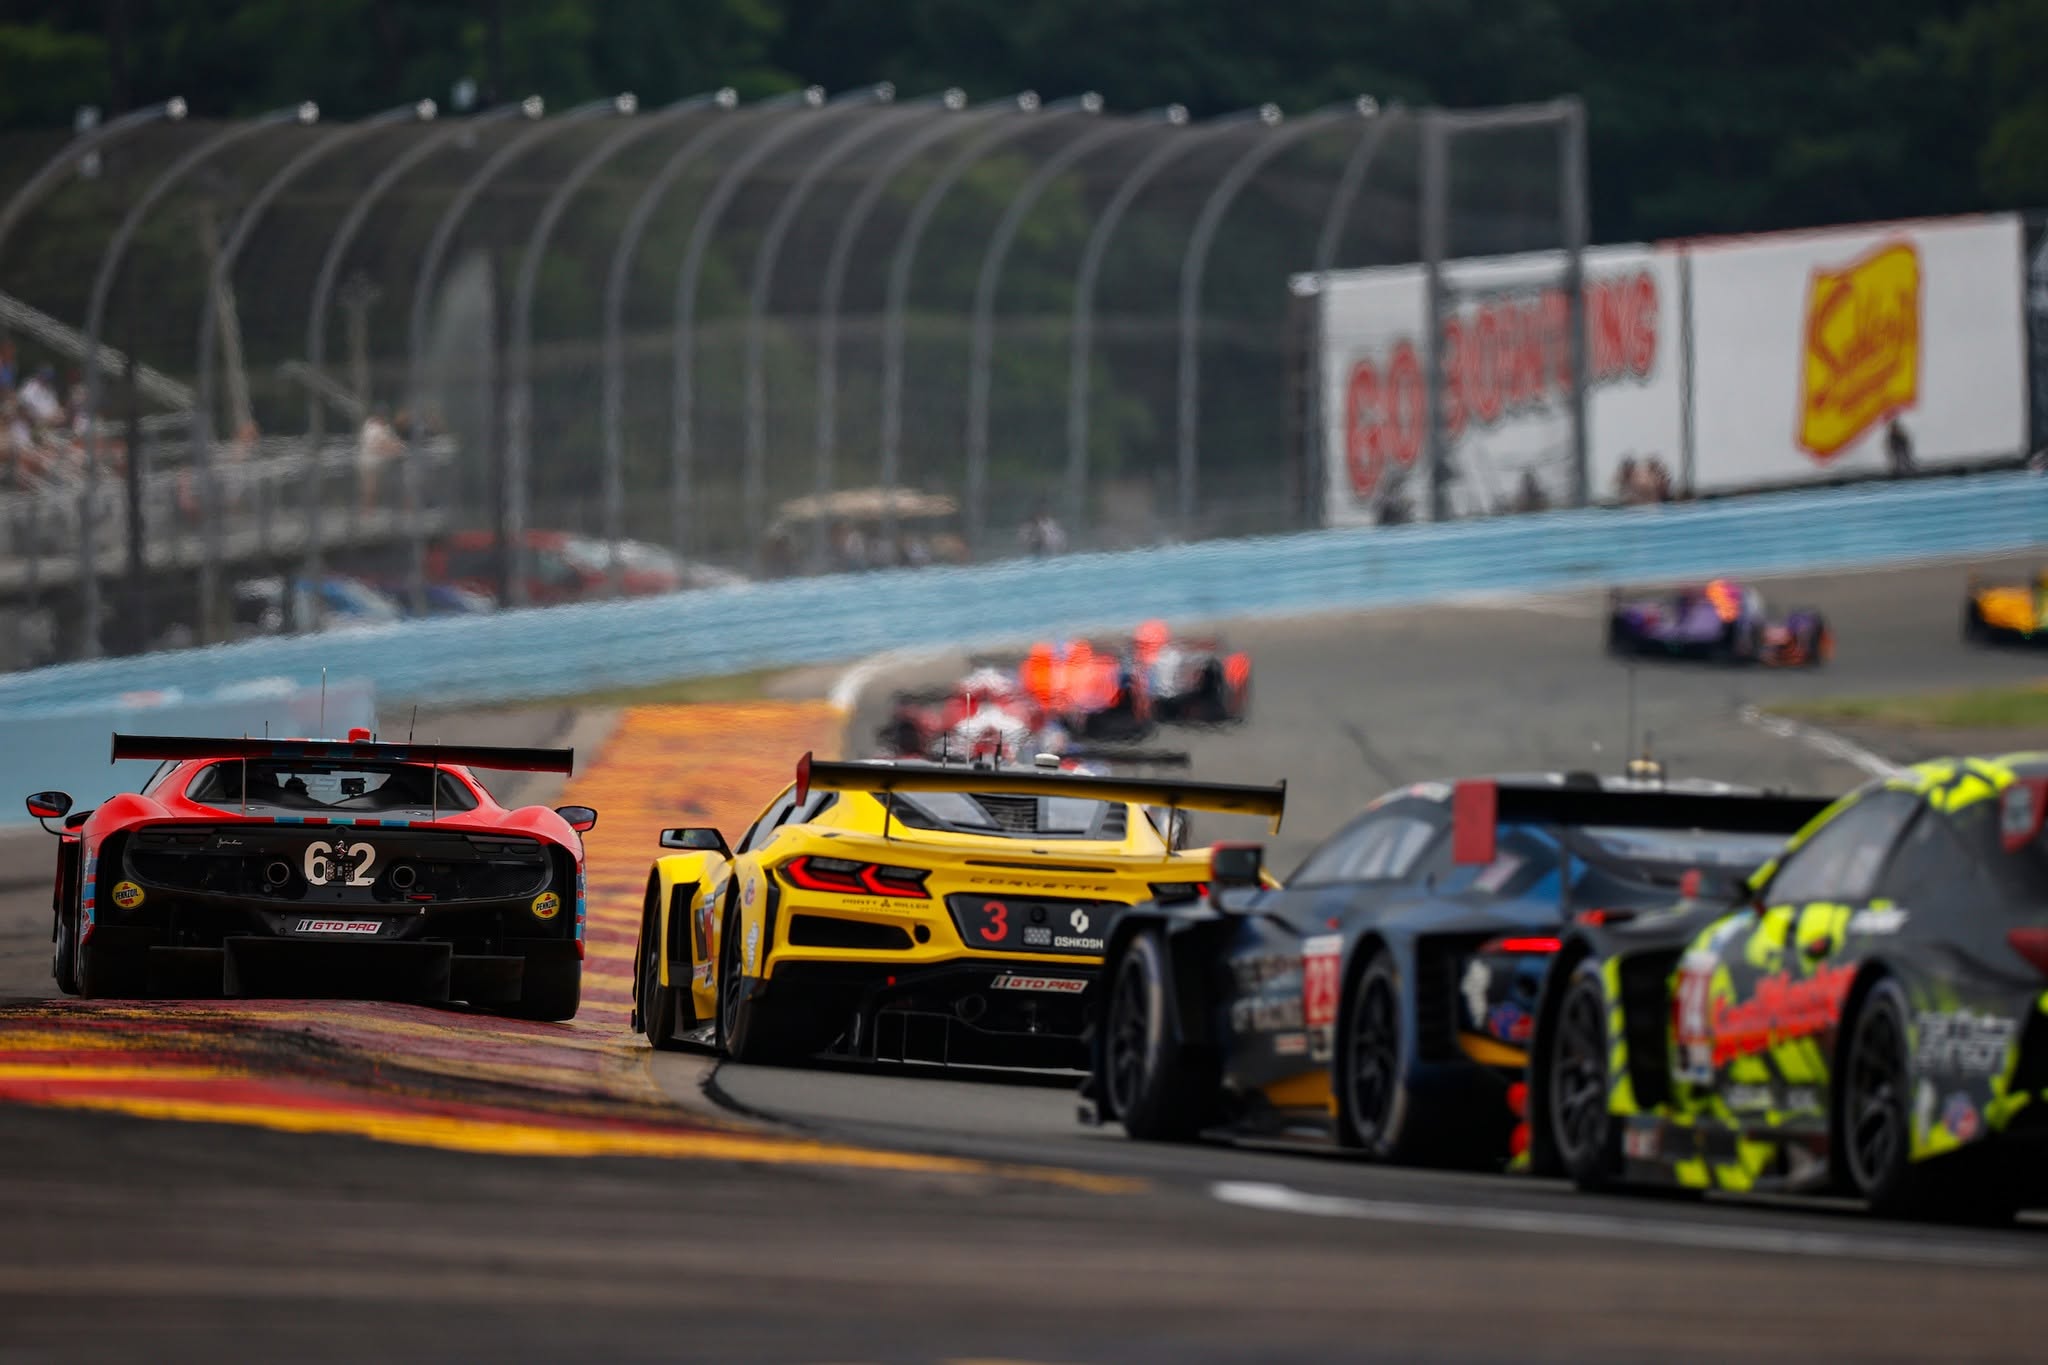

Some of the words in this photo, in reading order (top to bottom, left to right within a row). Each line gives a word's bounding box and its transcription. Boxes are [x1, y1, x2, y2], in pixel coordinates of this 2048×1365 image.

[1344, 338, 1428, 497] GO
[1441, 271, 1658, 441] BOWLNG
[304, 841, 376, 887] 62
[969, 875, 1109, 892] CORVETTE
[115, 888, 139, 901] PENNZOIL
[312, 922, 344, 931] GTD
[346, 923, 378, 932] PRO
[980, 901, 1008, 941] 3
[1054, 936, 1104, 949] OSHKOSH
[1010, 977, 1046, 988] GTD
[1047, 979, 1083, 991] PRO
